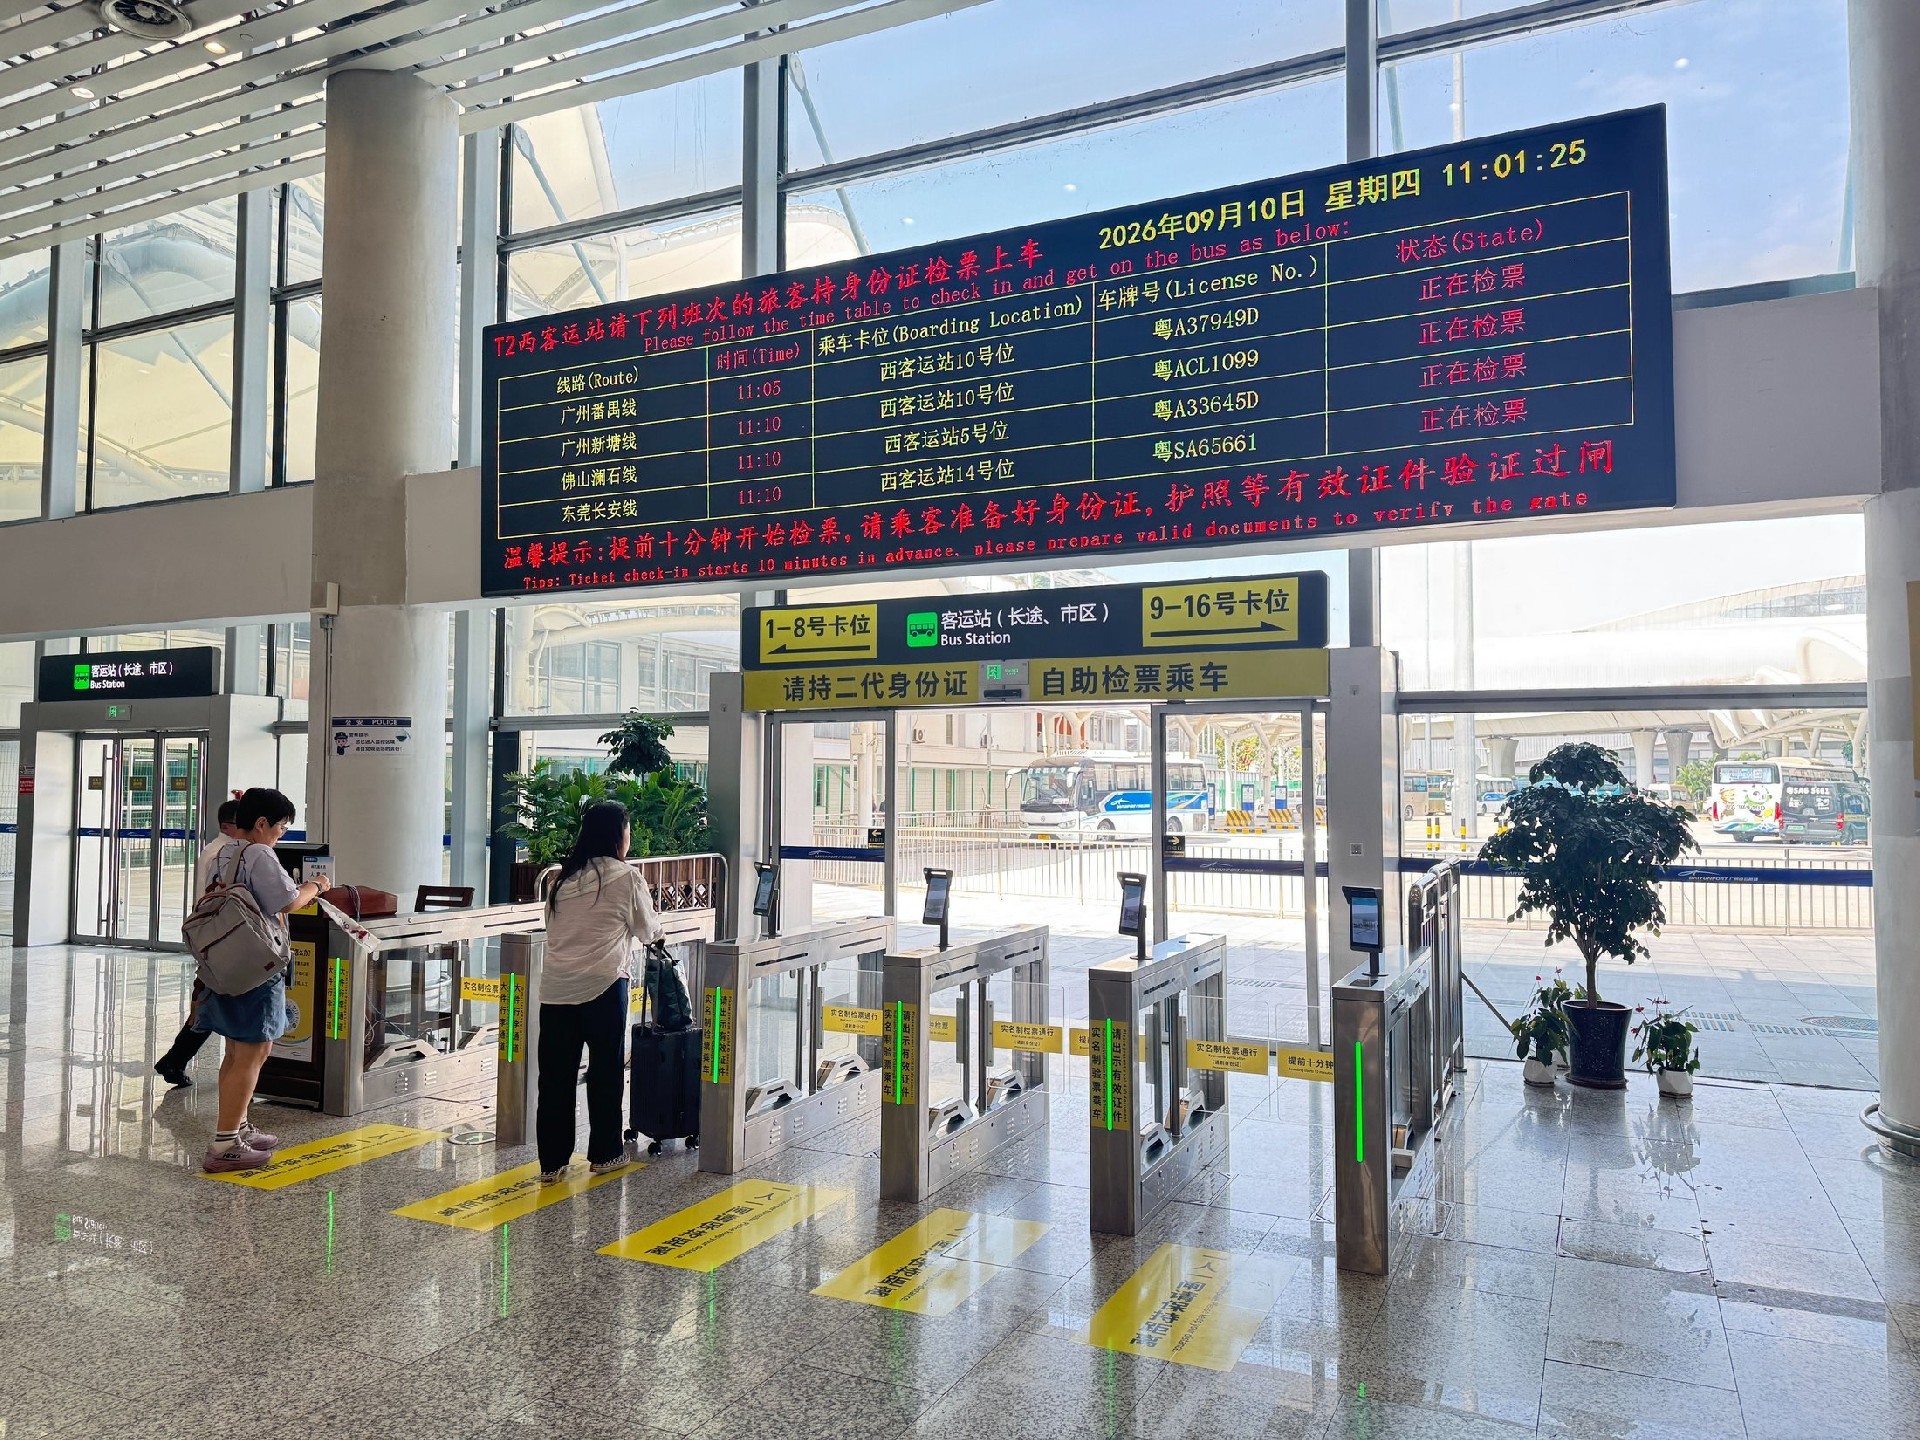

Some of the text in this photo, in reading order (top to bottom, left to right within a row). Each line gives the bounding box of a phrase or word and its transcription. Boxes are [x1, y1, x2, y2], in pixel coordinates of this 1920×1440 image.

[1099, 138, 1587, 249] 2026年09月10日 星期四 11:01:25
[1396, 218, 1545, 264] 状态(State)
[494, 238, 1043, 357] T2西客运站请下列班次的旅客持身份证检票上车
[644, 219, 1351, 353] Please follow the time table to check in and get on the bus as below:
[1097, 254, 1318, 312] 车牌号(License No.)
[1418, 262, 1526, 302] 正在检票
[818, 294, 1083, 357] 乘车卡位(Boarding Location)
[1152, 307, 1260, 341] 粤A37949D
[1418, 308, 1526, 346] 正在检票
[716, 342, 801, 371] 时间(Time)
[879, 342, 1015, 382] 西客运站10号位
[1152, 349, 1260, 382] 粤ACL1099
[1418, 352, 1527, 388] 正在检票
[556, 365, 640, 395] 线路(Route)
[738, 380, 782, 401] 11:05
[561, 398, 637, 425] 广州番禺线
[879, 381, 1015, 419] 西客运站10号位
[1152, 390, 1260, 422] 粤A33645D
[1418, 397, 1528, 433] 正在检票
[738, 416, 782, 437] 11:10
[884, 420, 1010, 455] 西客运站5号位
[561, 431, 637, 458] 广州新塘线
[738, 450, 782, 471] 11:10
[1152, 433, 1257, 462] 粤SA65661
[561, 465, 637, 490] 佛山澜石线
[880, 458, 1016, 493] 西客运站14号位
[561, 499, 638, 523] 东莞长安线
[738, 486, 782, 506] 11:10
[569, 573, 615, 586] Ticket
[624, 566, 689, 581] check-in
[698, 561, 748, 576] starts
[759, 559, 775, 572] 10
[784, 554, 847, 571] minutes
[858, 551, 875, 565] in
[974, 539, 1036, 556] please
[1046, 533, 1123, 550] prepare
[1137, 523, 1193, 542] valid
[1206, 514, 1317, 537] documents
[1334, 511, 1358, 526] to
[1374, 501, 1454, 522] verify
[1472, 496, 1512, 514] the
[1529, 491, 1588, 510] gate
[1150, 589, 1290, 620] 9-16号卡位
[766, 613, 871, 639] 1-8号卡位
[941, 631, 1011, 646] Bus Station
[90, 679, 125, 689] Bus Station
[783, 670, 968, 702] 请持二代身份证
[1042, 660, 1229, 696] 自助检票乘车
[1196, 1043, 1258, 1057] 实名制检票通行
[1112, 1028, 1122, 1123] 请出示有效证件
[644, 1187, 791, 1256] 一人一闸请保持距离
[1129, 1254, 1229, 1348] 一人一闸请保持距离
